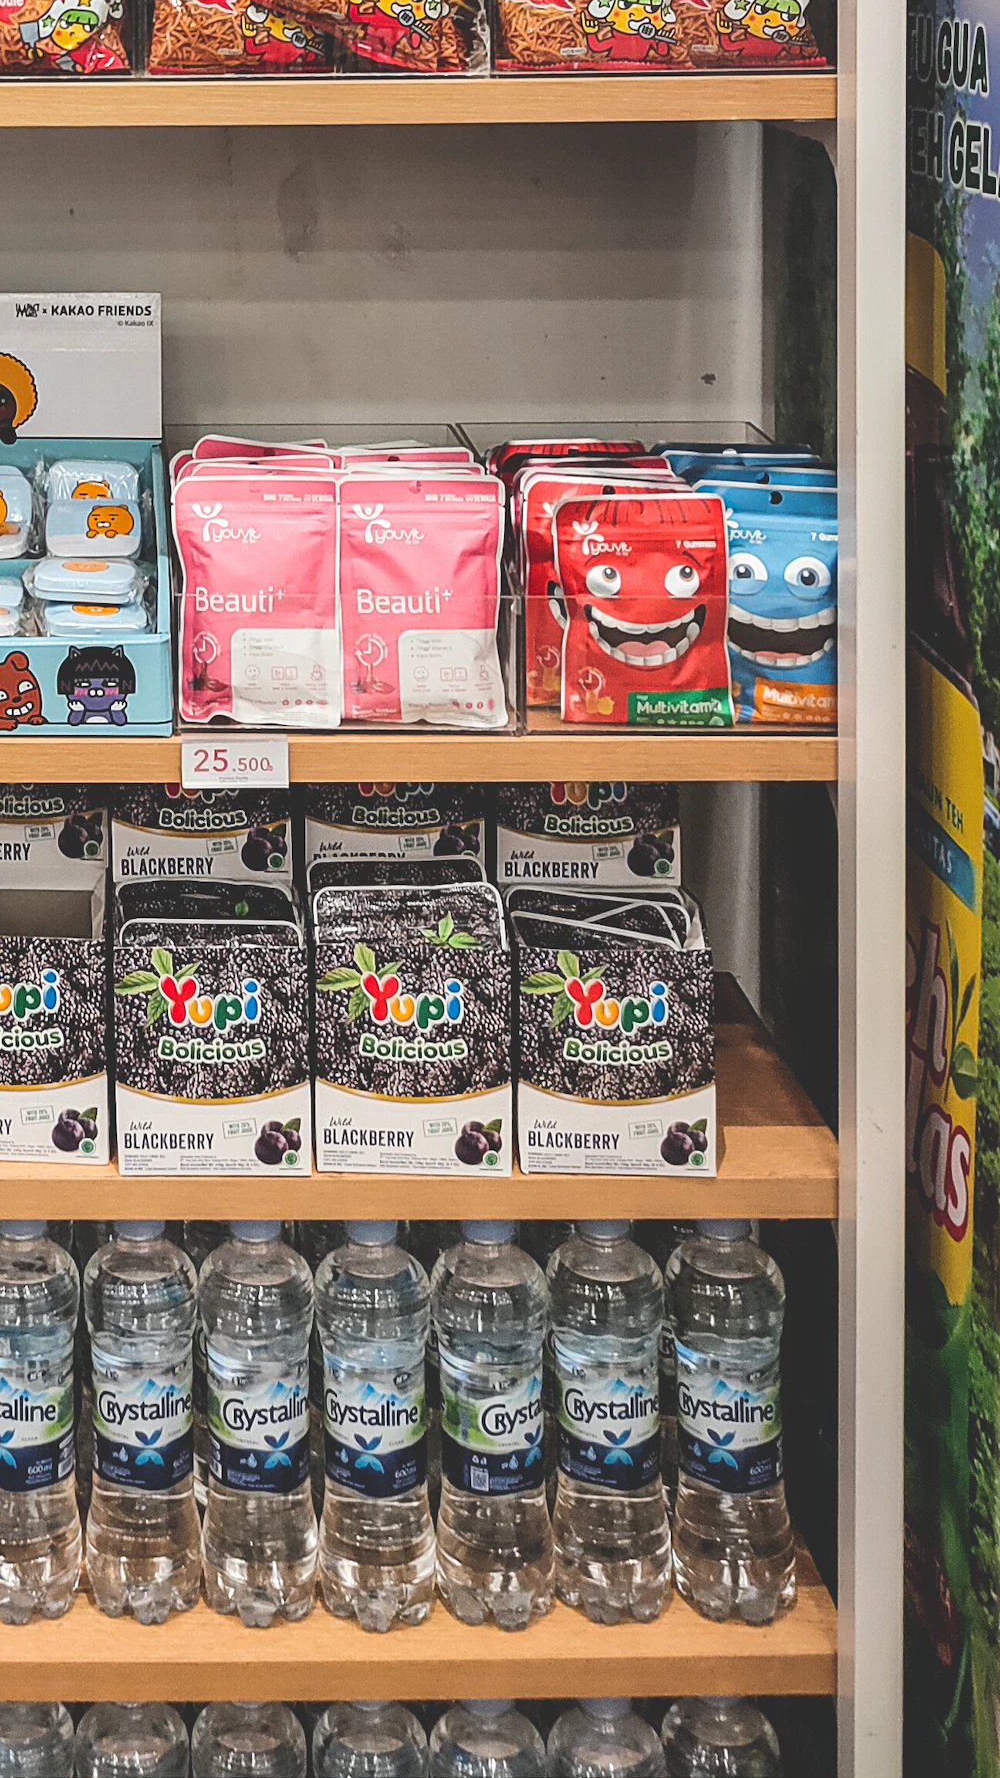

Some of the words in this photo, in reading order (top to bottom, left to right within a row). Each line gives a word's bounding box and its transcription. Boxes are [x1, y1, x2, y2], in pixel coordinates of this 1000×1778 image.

[937, 18, 990, 98] GUA
[948, 115, 1000, 199] GEL
[51, 305, 95, 317] KAKAO
[97, 304, 153, 317] FRIENDS
[193, 748, 270, 773] 25.500
[126, 845, 150, 859] Wild
[120, 857, 214, 877] BLACKBERRY
[503, 860, 599, 879] BLACKBERRY
[158, 975, 261, 1033] Yupi
[359, 972, 464, 1033] Yupi
[564, 978, 669, 1036] Yupi
[157, 1036, 266, 1064] Bolicious
[358, 1033, 468, 1063] Bolicious
[562, 1037, 673, 1065] Bolicious
[129, 1120, 152, 1132] Wild
[323, 1127, 415, 1149] BLACKBERRY
[123, 1131, 215, 1151] BLACKBERRY
[528, 1129, 621, 1151] BLACKBERRY
[222, 1396, 308, 1432] Crystallin
